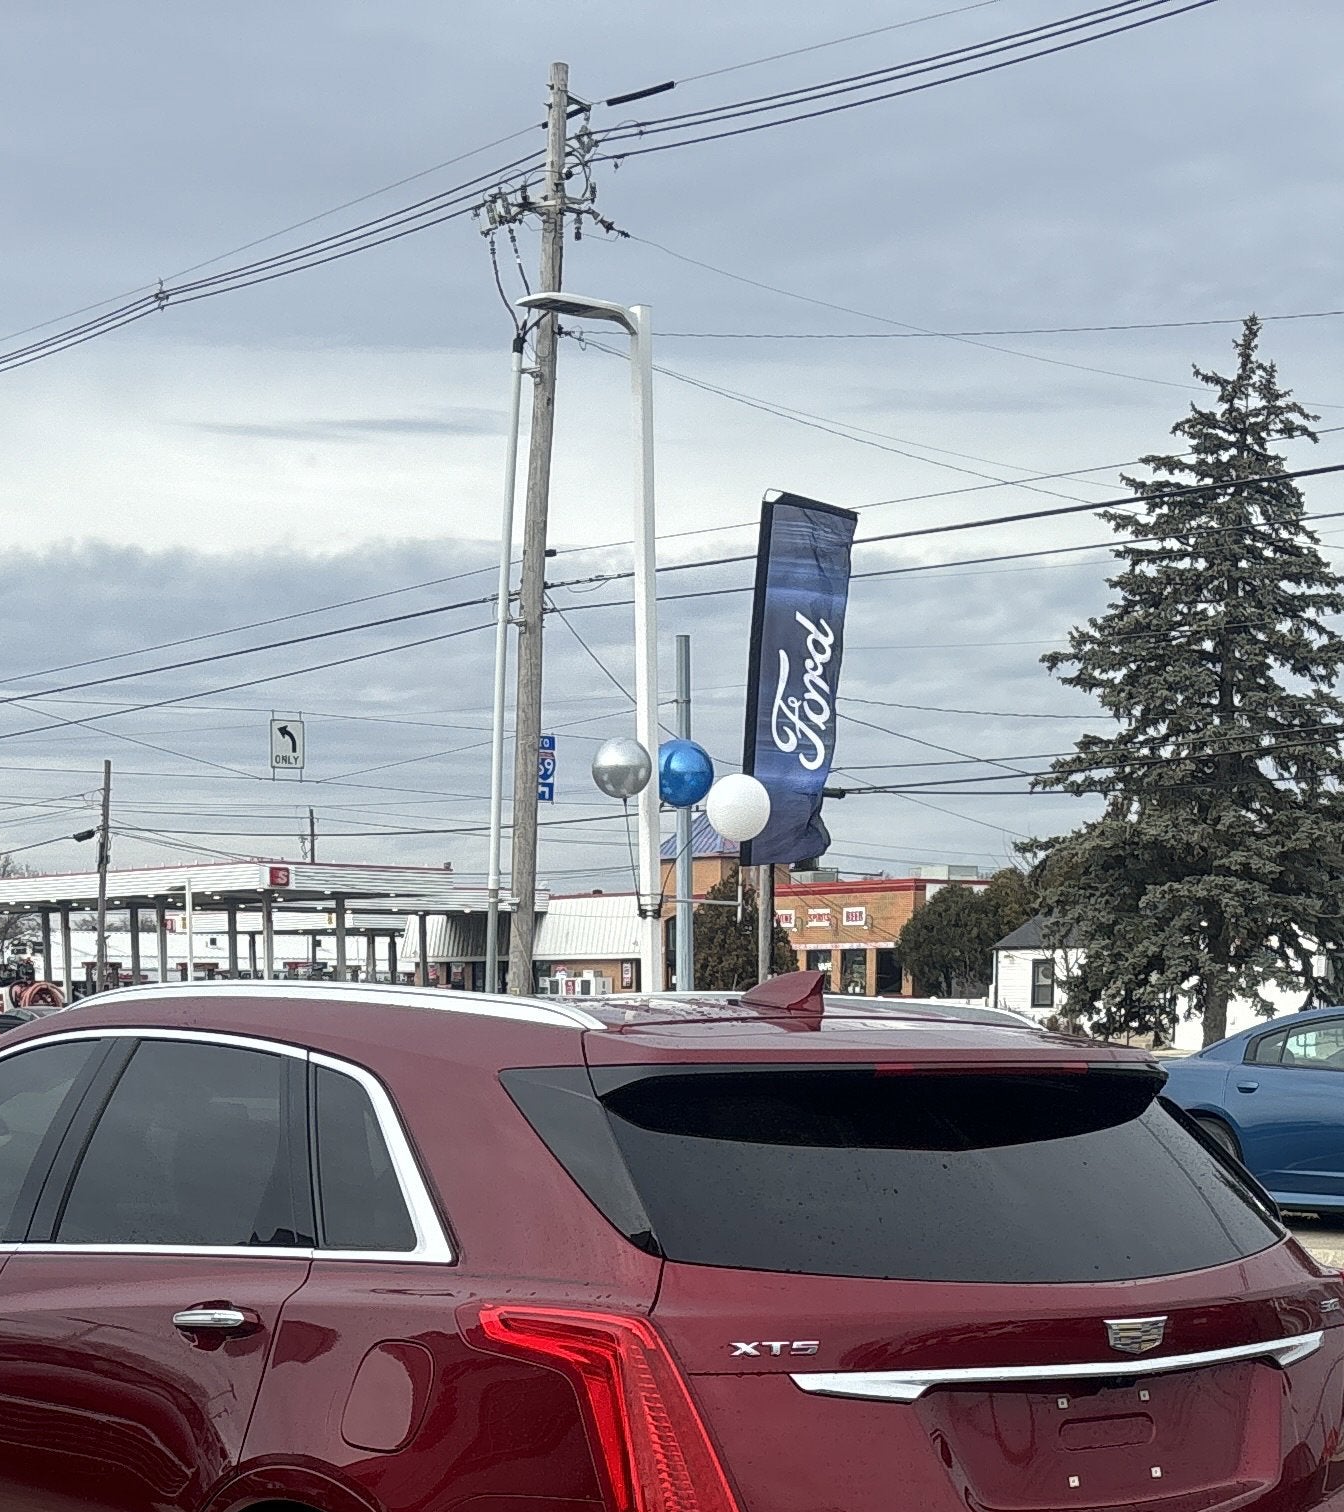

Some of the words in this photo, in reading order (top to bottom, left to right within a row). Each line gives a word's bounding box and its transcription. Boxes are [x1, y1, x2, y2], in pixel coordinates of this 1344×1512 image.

[771, 611, 835, 771] Ford
[274, 754, 300, 766] ONLY
[845, 910, 864, 922] BEER
[729, 1340, 820, 1356] XT5
